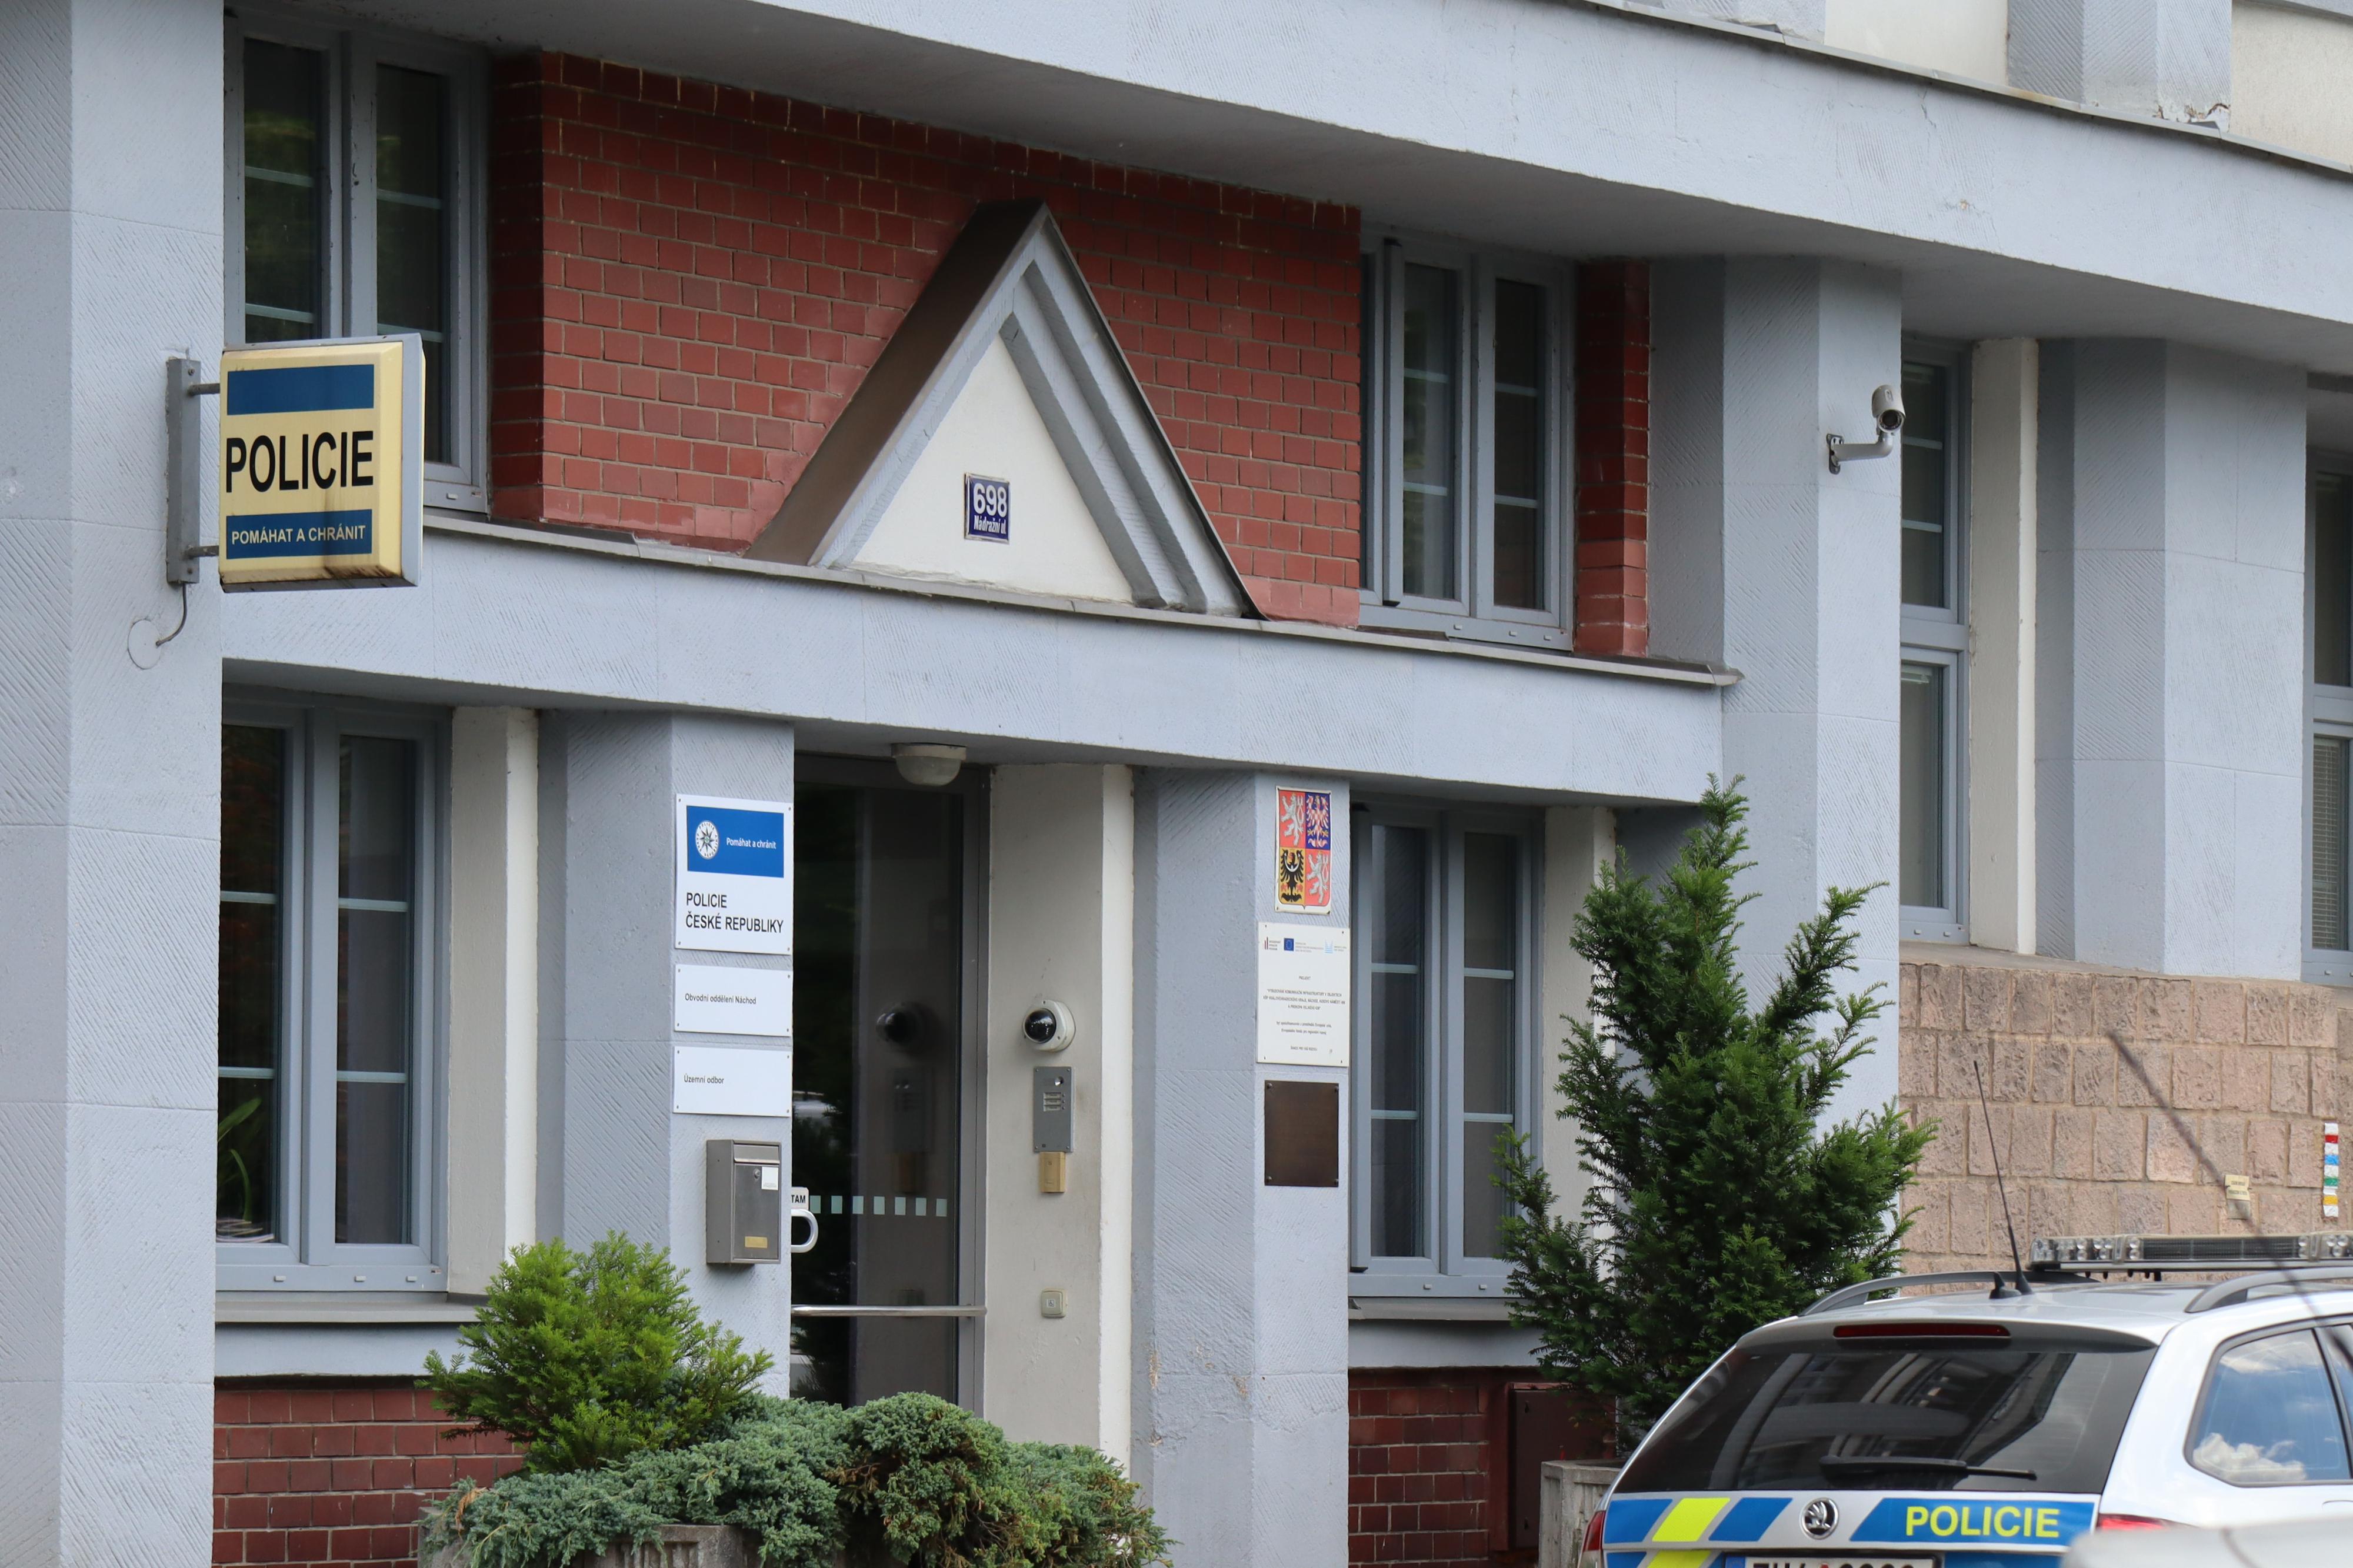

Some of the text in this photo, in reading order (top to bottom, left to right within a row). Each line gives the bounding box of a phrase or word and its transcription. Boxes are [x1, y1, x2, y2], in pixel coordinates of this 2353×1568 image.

[226, 431, 373, 492] POLICIE
[974, 483, 1007, 518] 698
[232, 522, 366, 544] POMÁHAT A CHRÁNIT
[974, 515, 1000, 533] Nádražní
[726, 838, 751, 848] Pomáhat
[756, 840, 776, 849] chránit
[686, 892, 727, 909] POLICIE
[685, 910, 784, 933] ČESKÉ REPUBLIKY
[685, 993, 756, 1005] Obvodní oddělení Náchod
[684, 1073, 724, 1085] Územní odbor
[791, 1195, 806, 1203] TAM
[1905, 1505, 2060, 1539] POLICIE
